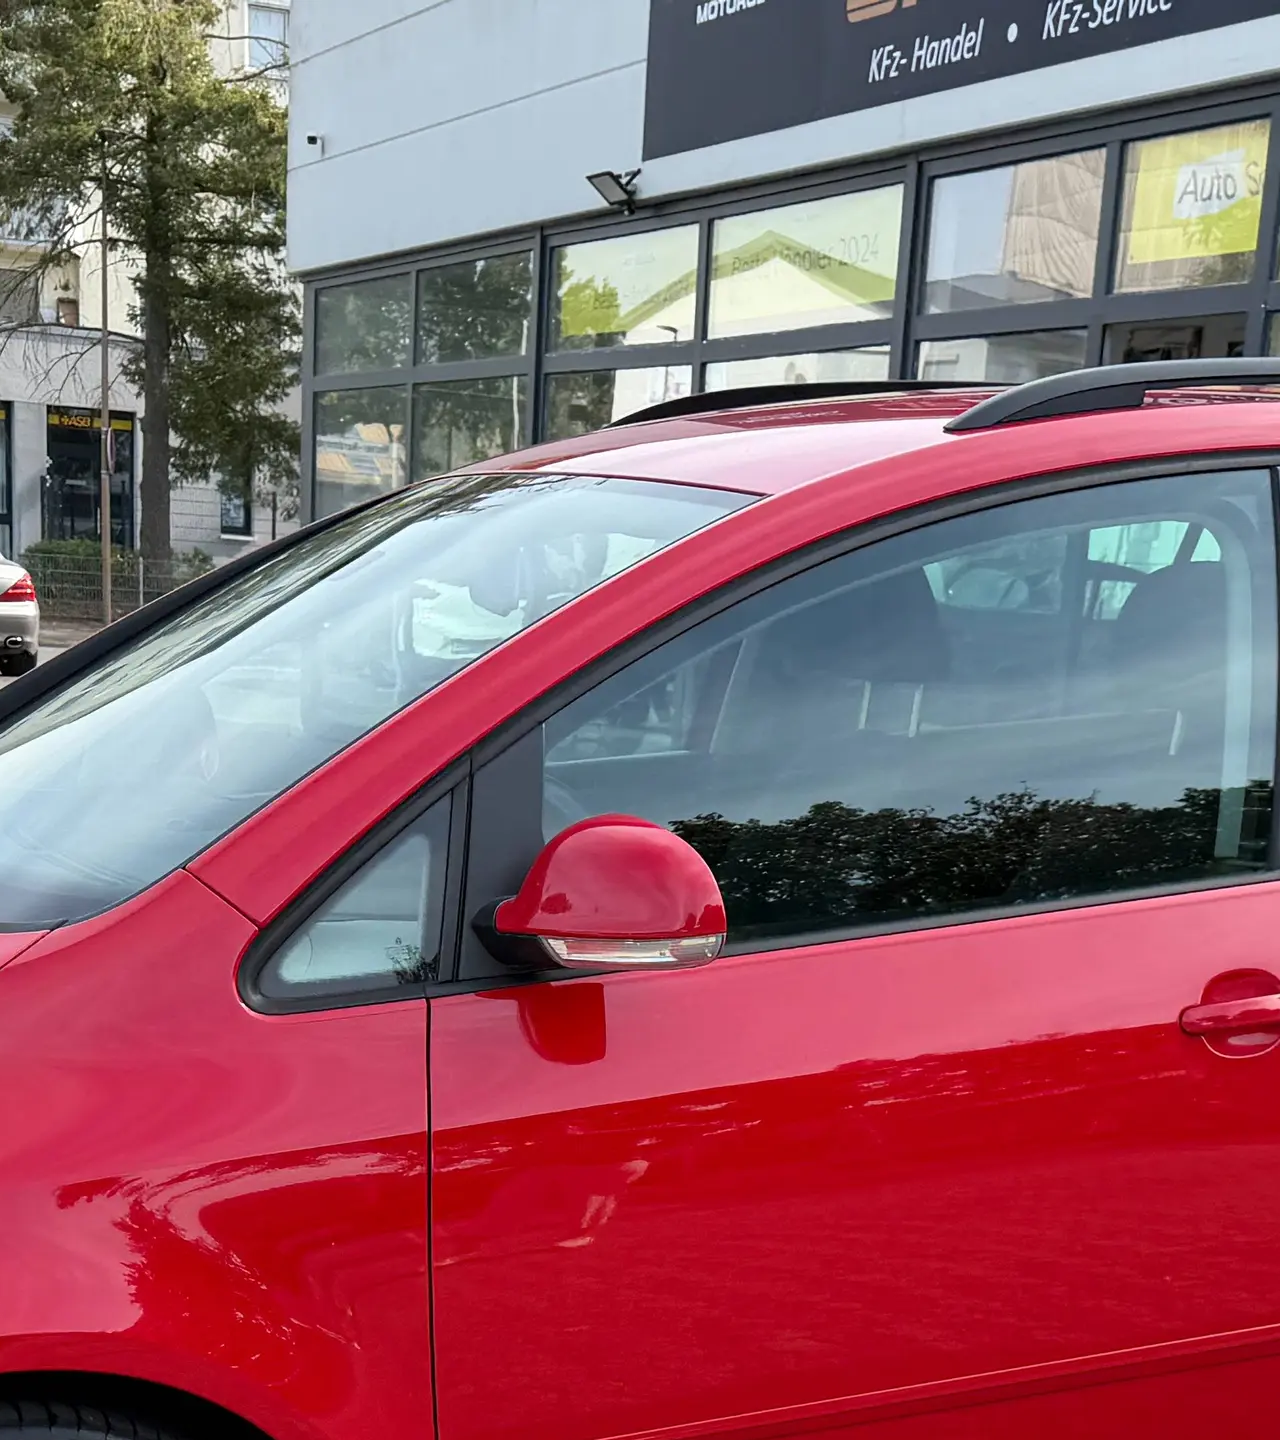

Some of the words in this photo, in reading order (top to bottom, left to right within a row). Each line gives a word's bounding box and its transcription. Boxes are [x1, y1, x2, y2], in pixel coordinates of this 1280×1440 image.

[911, 19, 984, 73] Handel
[1042, 0, 1173, 40] KFz-Service
[1177, 165, 1238, 205] Auto
